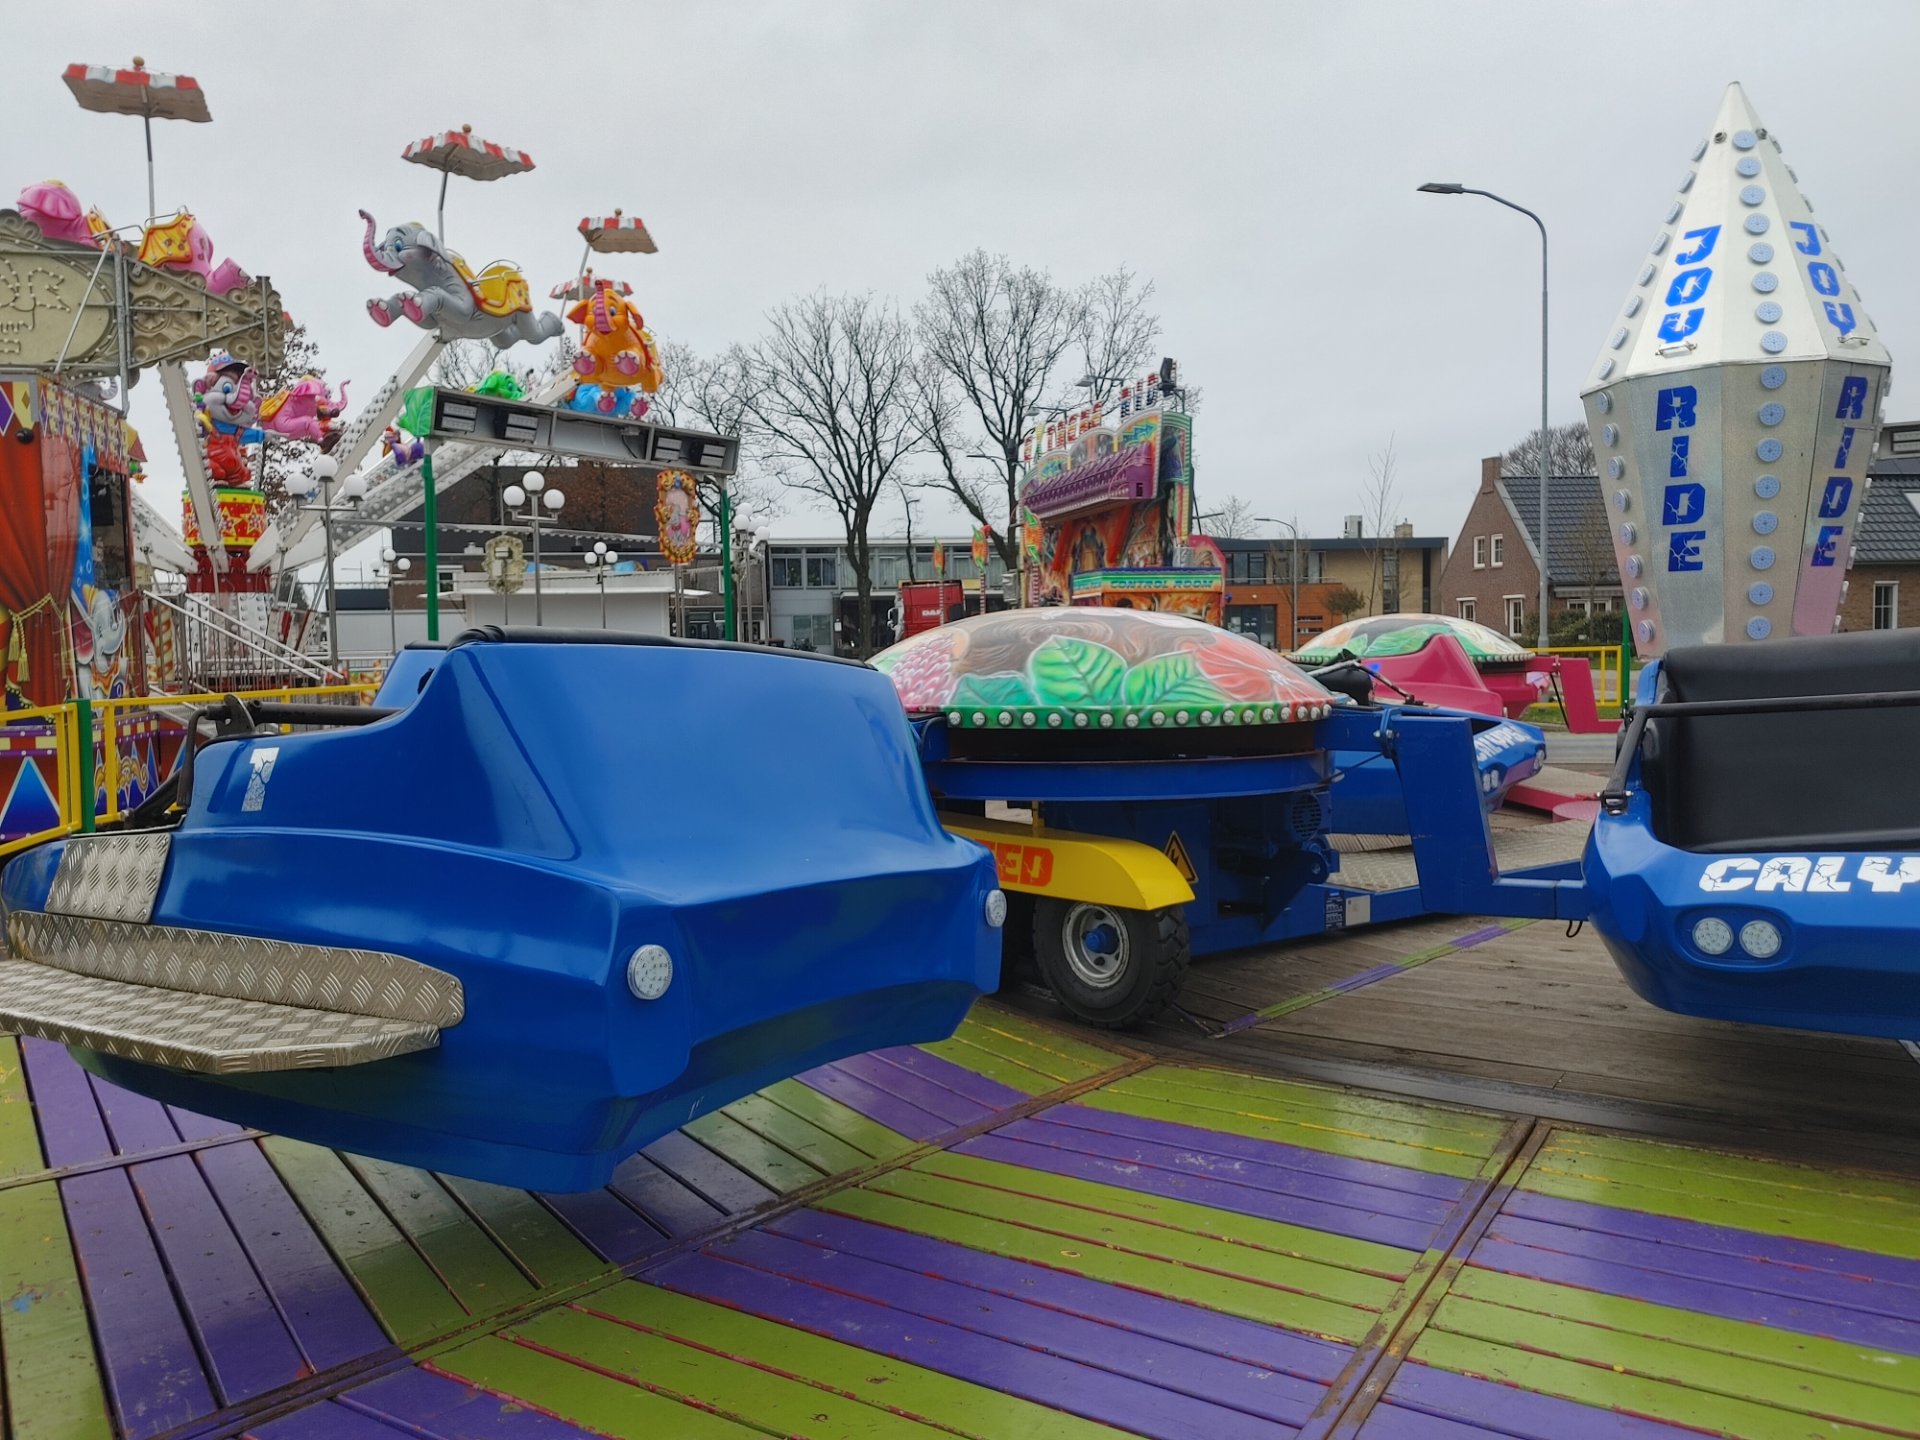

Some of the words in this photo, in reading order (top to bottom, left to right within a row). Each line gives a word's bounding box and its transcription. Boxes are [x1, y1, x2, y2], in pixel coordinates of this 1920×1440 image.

[1657, 224, 1722, 343] JOY
[1789, 221, 1857, 337] JOY
[1656, 385, 1706, 572] RIDE
[1811, 376, 1868, 566] RIDE
[1109, 580, 1169, 589] CONTROL
[1173, 579, 1213, 588] ROOM
[241, 747, 280, 812] 1
[974, 838, 1055, 887] ED
[1699, 857, 1920, 892] CALY
